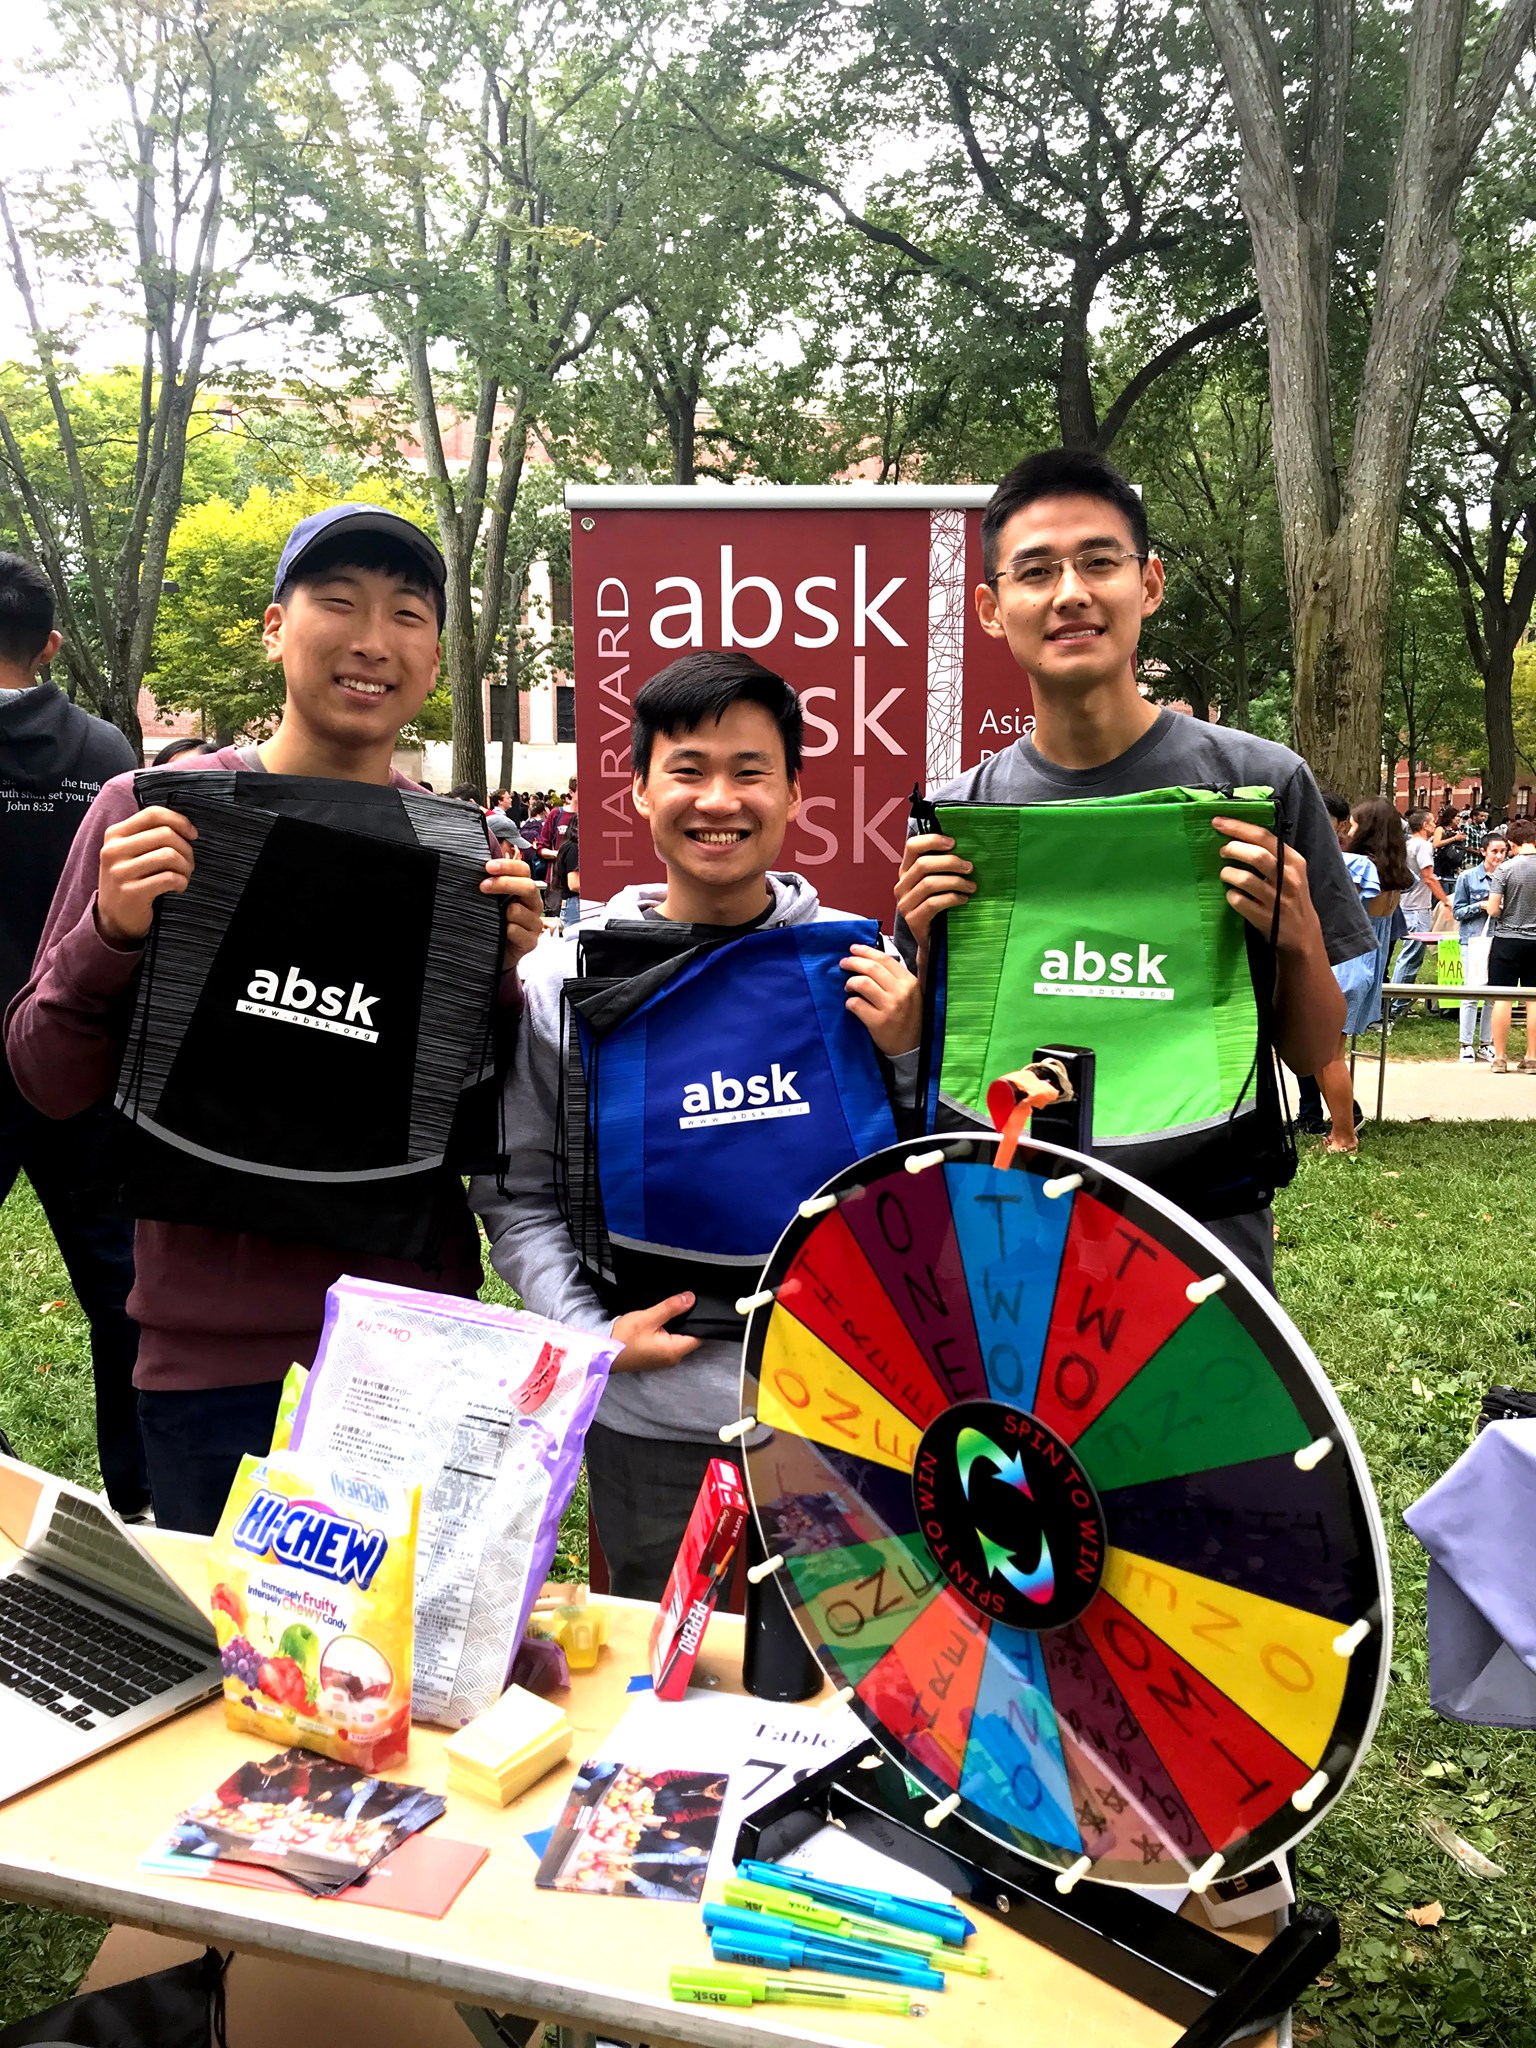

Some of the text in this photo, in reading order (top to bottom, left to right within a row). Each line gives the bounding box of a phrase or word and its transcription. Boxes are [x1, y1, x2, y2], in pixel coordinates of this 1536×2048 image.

[650, 544, 908, 649] absk
[597, 577, 634, 867] HARVARD
[979, 708, 1037, 734] Asia
[5, 801, 54, 813] John 8:32
[48, 791, 63, 800] set
[65, 792, 85, 803] you
[80, 780, 101, 791] truth
[1040, 941, 1168, 985] absk
[244, 1003, 371, 1041] www.absk.org
[247, 966, 381, 1027] absk
[682, 1063, 801, 1114] absk
[876, 1191, 976, 1400] ONE
[974, 1194, 1025, 1398] TWO
[1054, 1227, 1159, 1411] TWO
[793, 1250, 934, 1420] THREE
[774, 1368, 917, 1467] ONE
[1004, 1414, 1099, 1584] SPIN TO WIN
[234, 1491, 387, 1590] HI-CHEW
[917, 1450, 1006, 1613] SPIN TO WIN
[248, 1585, 348, 1632] Intensely Chewy Candy
[261, 1579, 338, 1616] Immensely Fruity
[677, 1599, 709, 1656] PEPERO
[1123, 1562, 1316, 1693] ONE
[753, 1722, 836, 1750] Table
[1103, 1618, 1275, 1807] TWO
[692, 1990, 728, 2002] absk
